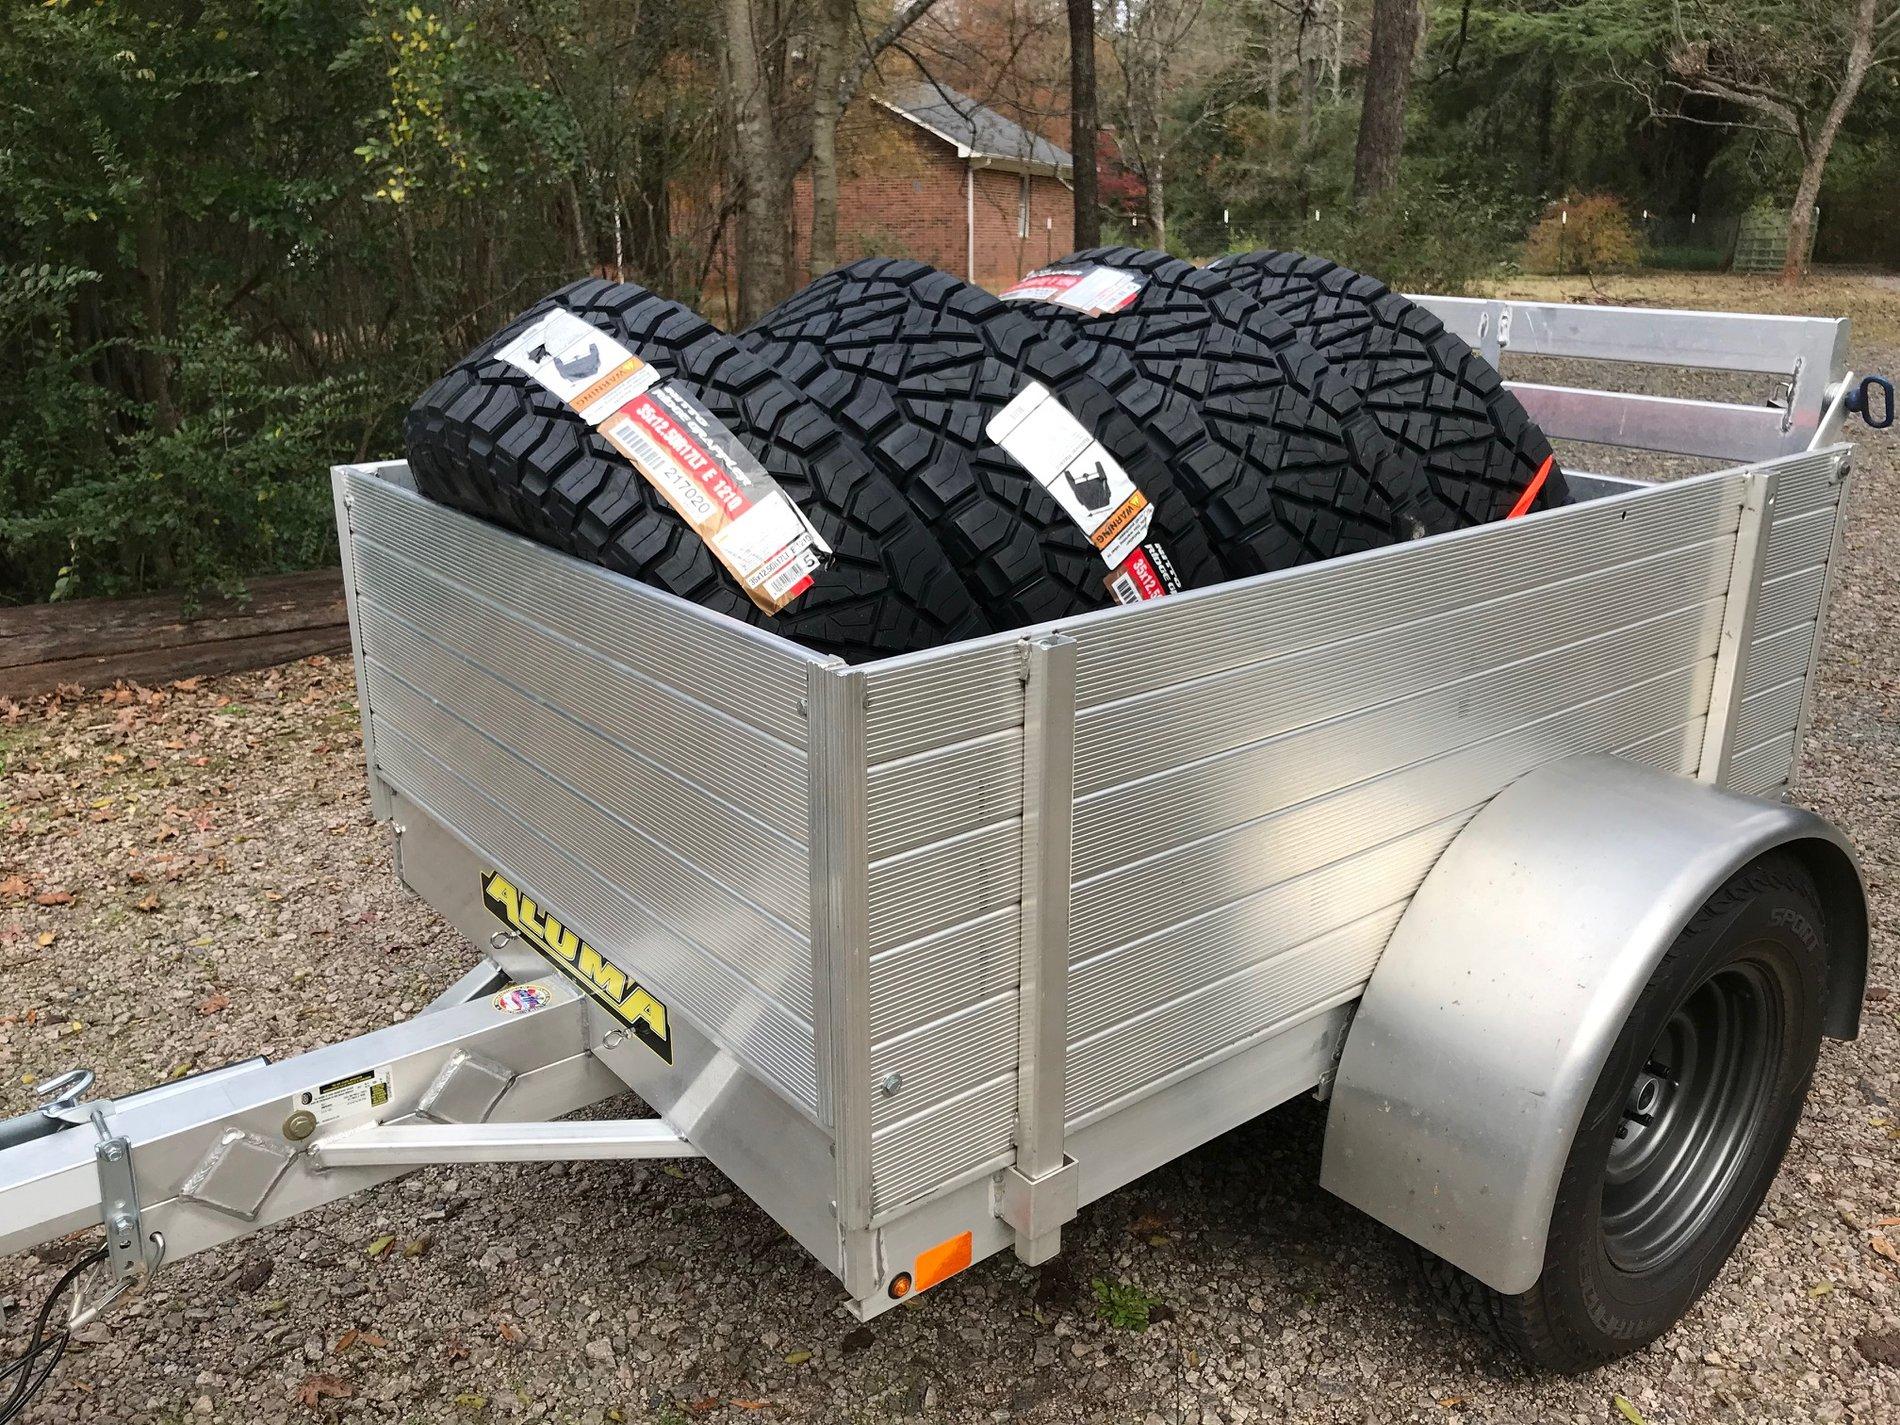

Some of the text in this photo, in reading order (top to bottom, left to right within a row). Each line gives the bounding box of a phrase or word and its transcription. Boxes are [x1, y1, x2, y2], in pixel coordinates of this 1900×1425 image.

[664, 467, 711, 514] 217020
[702, 468, 718, 482] E
[1096, 505, 1134, 544] WARNING
[803, 554, 815, 568] 5
[1144, 543, 1171, 581] RIDGE
[1154, 543, 1181, 588] NITTO
[485, 873, 668, 1042] ALUMA
